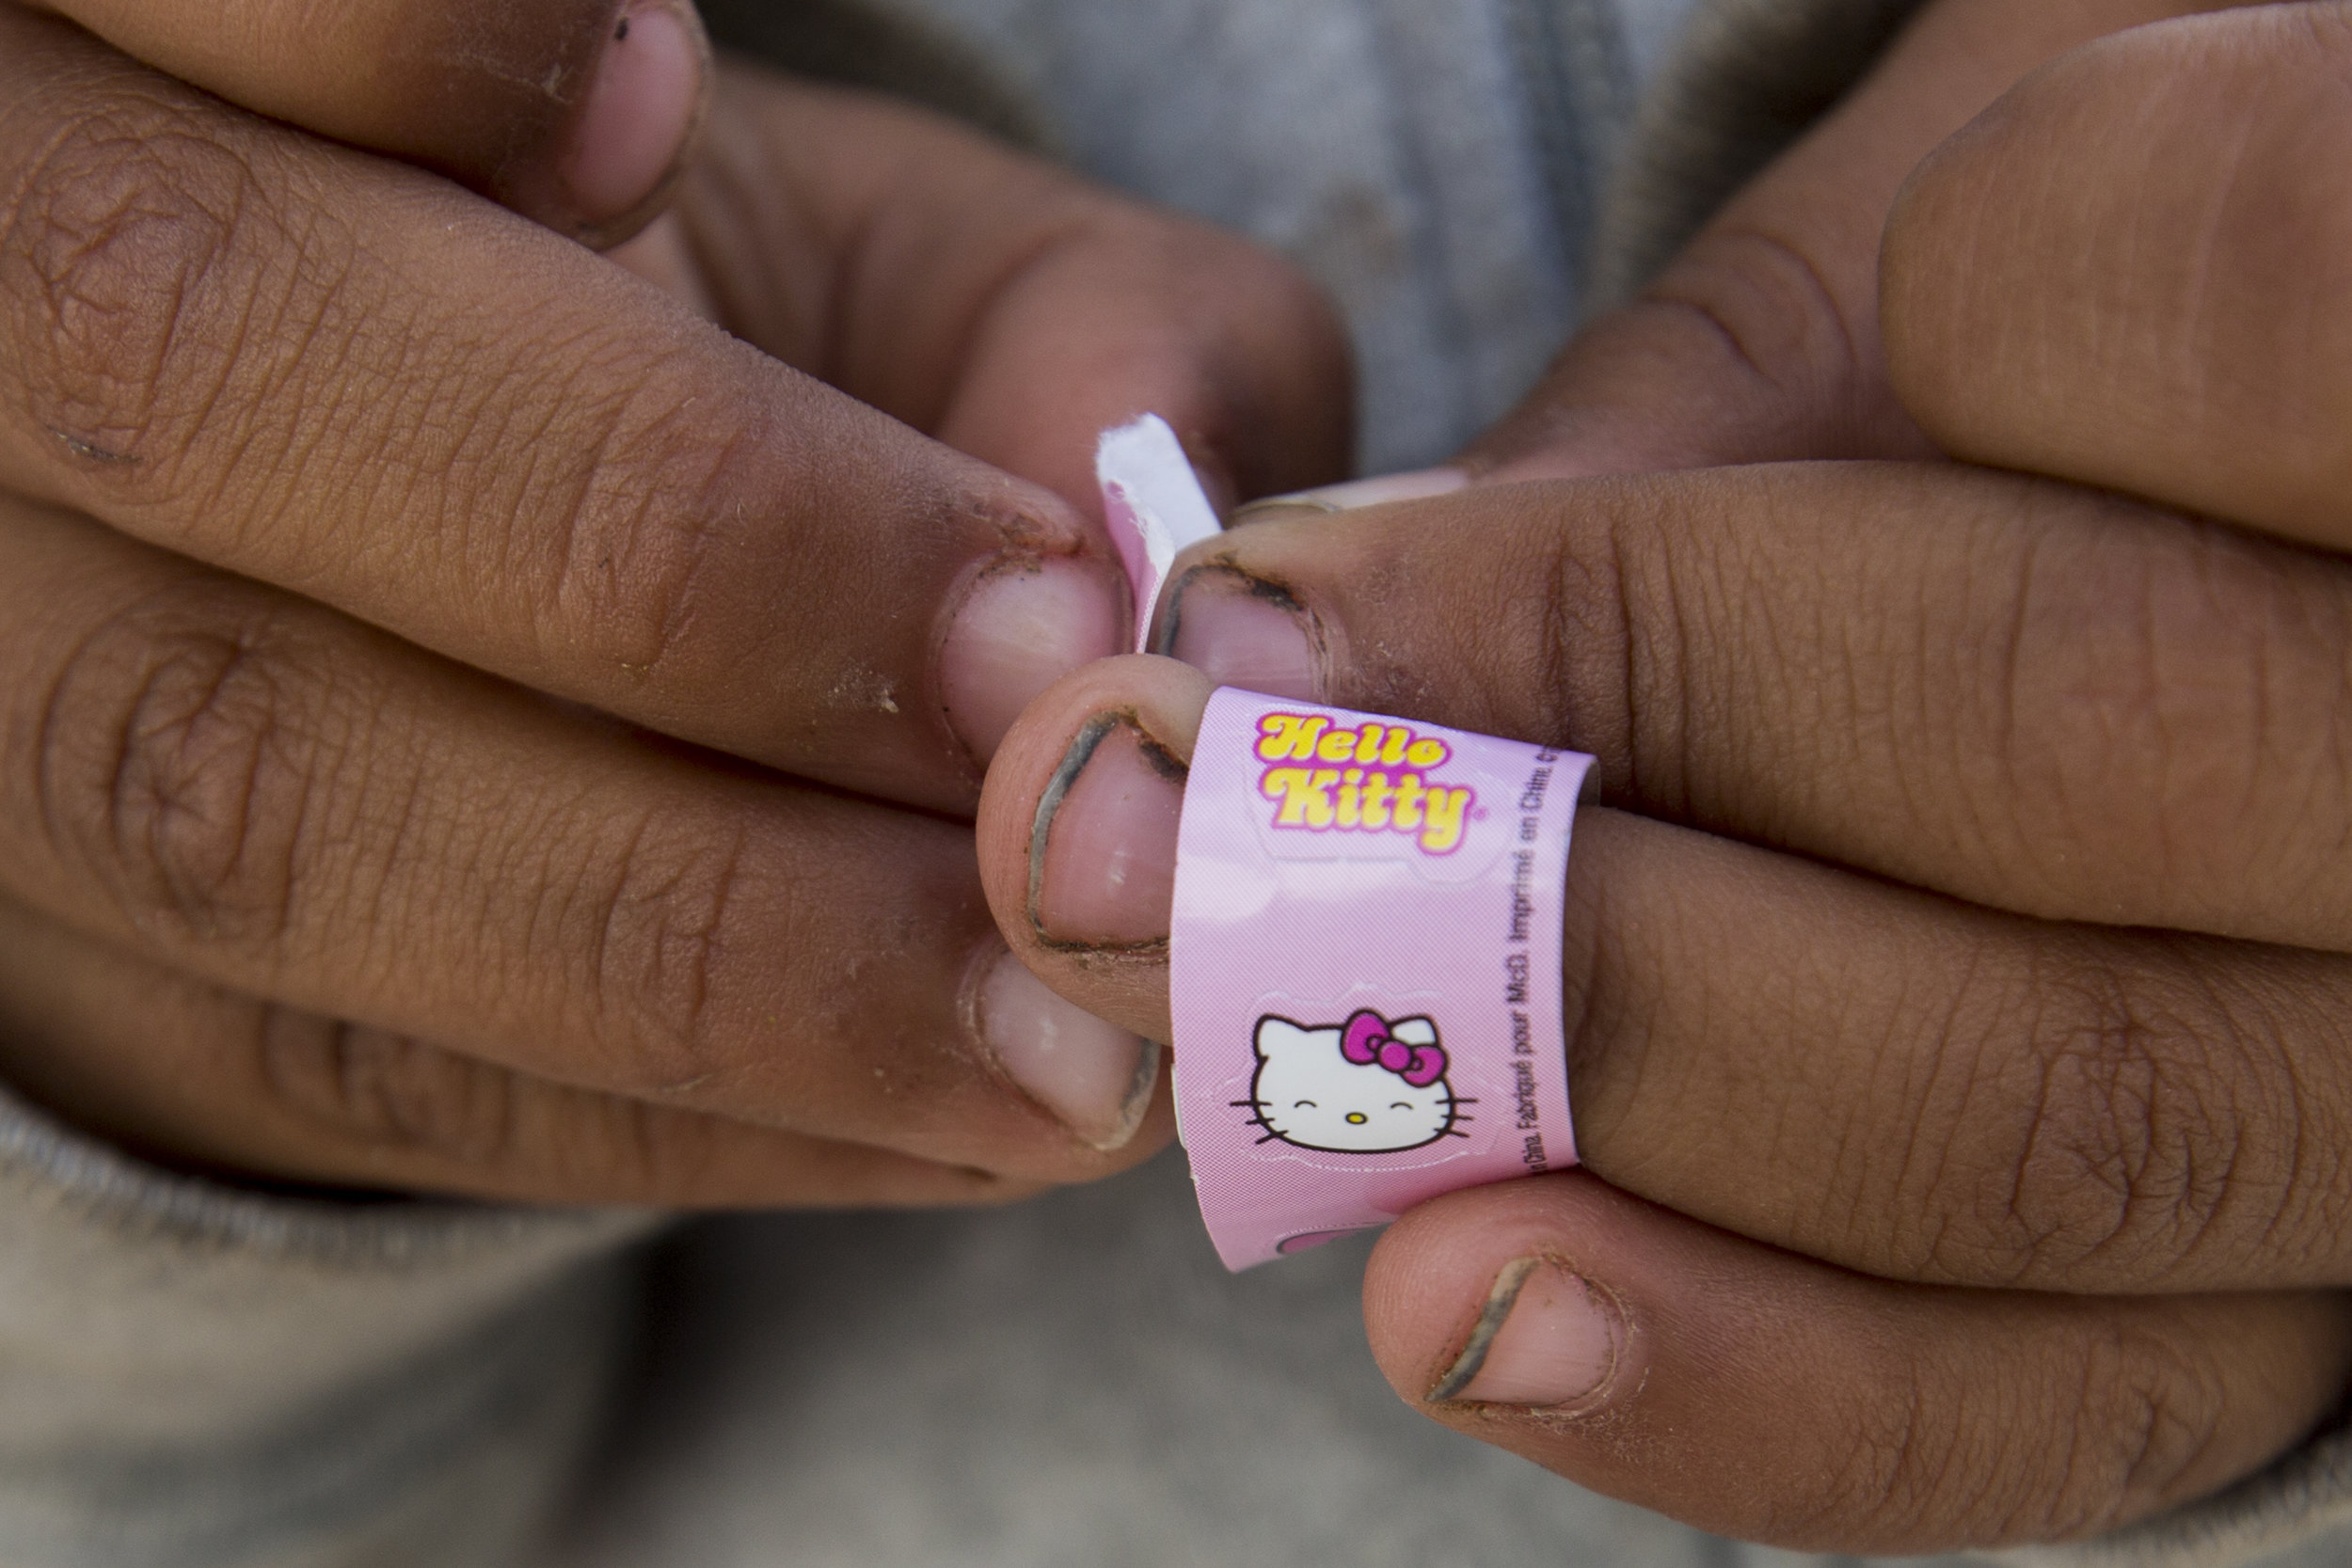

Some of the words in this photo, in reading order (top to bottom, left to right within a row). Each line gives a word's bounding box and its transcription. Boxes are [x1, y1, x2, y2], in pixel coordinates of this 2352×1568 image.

[1255, 712, 1451, 768] Hello
[1260, 765, 1474, 852] Kitty
[1520, 816, 1539, 841] en
[1509, 850, 1535, 941] Imprimé
[1507, 950, 1529, 1004] McD.
[1513, 1010, 1535, 1054] pour
[1511, 1061, 1539, 1129] Fabriqué
[1522, 1132, 1547, 1163] China.
